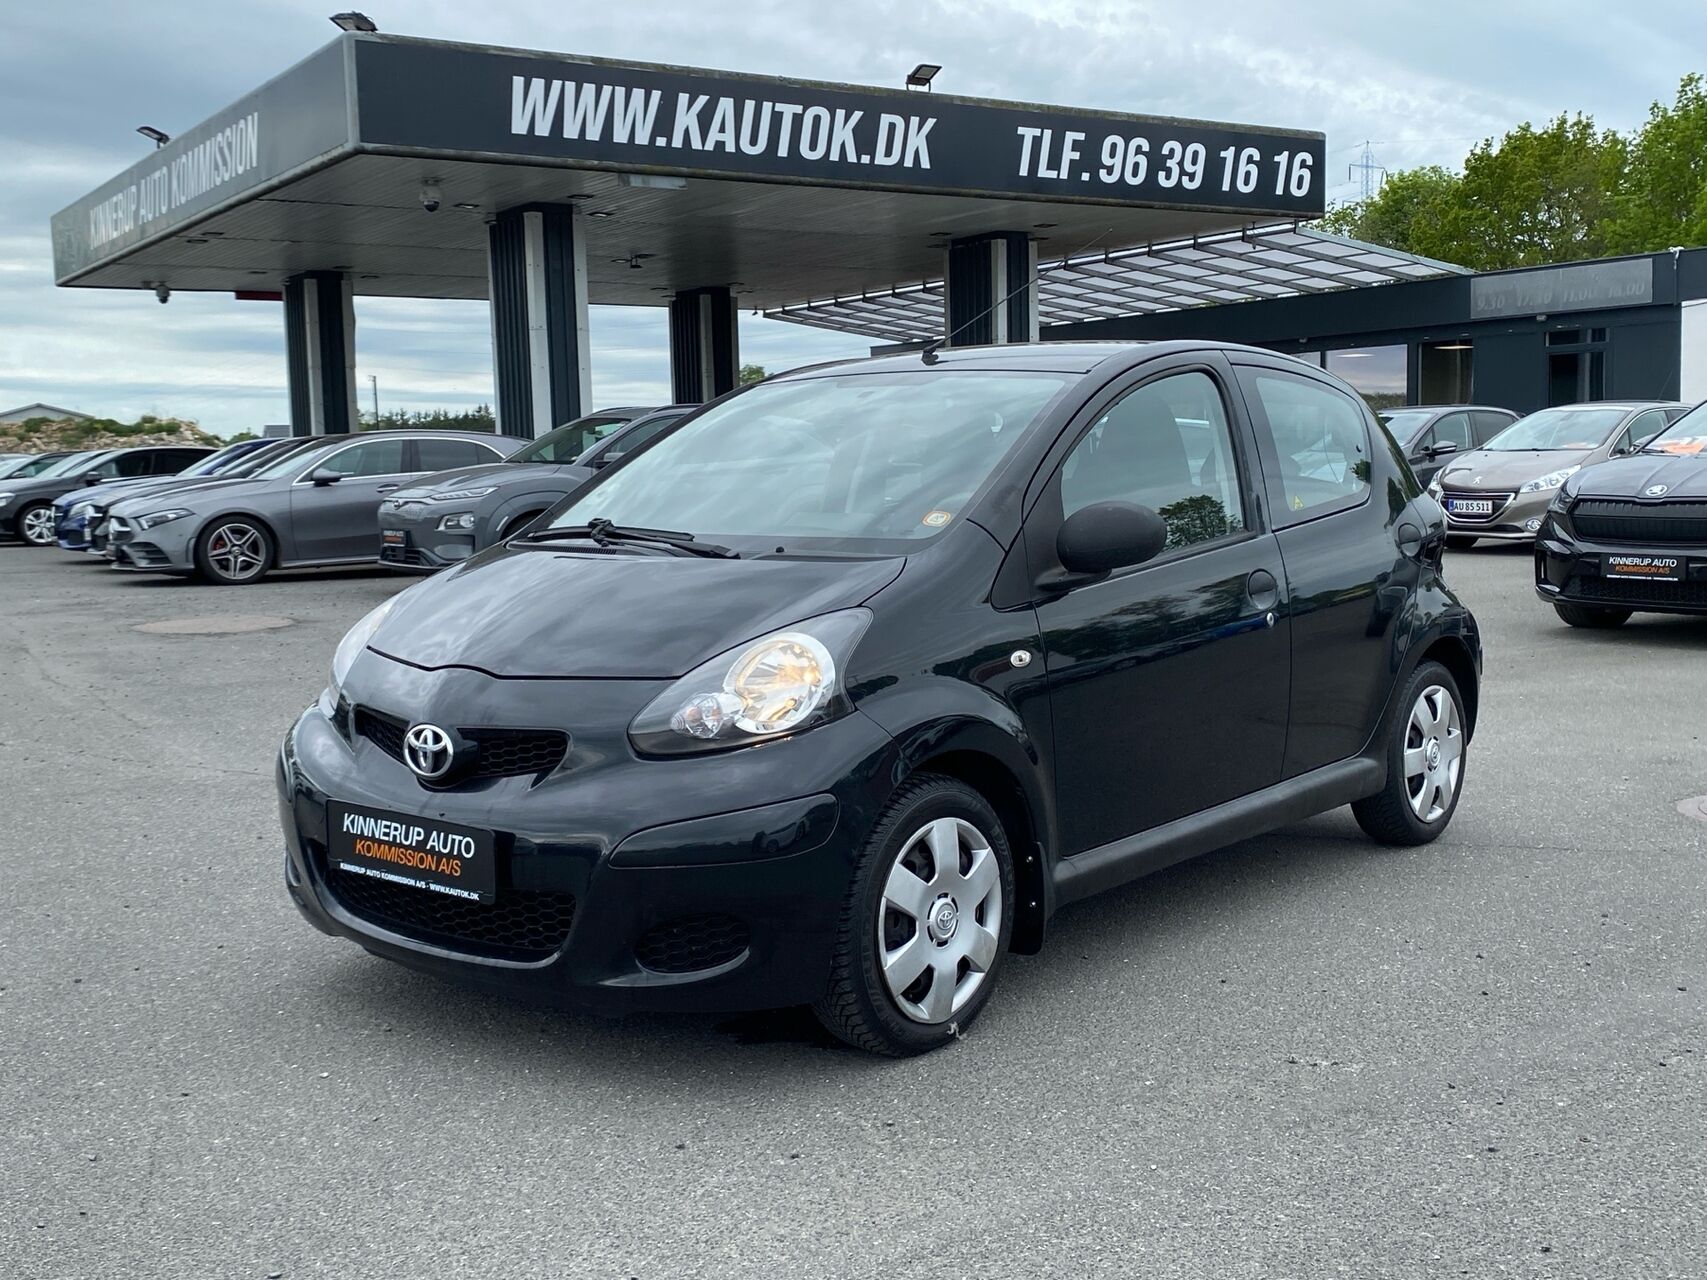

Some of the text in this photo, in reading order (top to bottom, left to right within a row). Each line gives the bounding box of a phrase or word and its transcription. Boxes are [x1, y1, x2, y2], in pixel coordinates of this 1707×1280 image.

[510, 75, 938, 170] WWW.KAUTOK.DK
[90, 112, 258, 250] KINNERUP AUTO KOMMISSION
[1016, 126, 1313, 197] TLF. 96 39 16 16
[1454, 502, 1490, 511] AU 85 511
[1608, 556, 1678, 567] KINNERUP AUTO
[343, 812, 475, 859] KINNERUP AUTO
[356, 839, 462, 877] KOMMISSION A/S
[366, 868, 381, 879] AUTO
